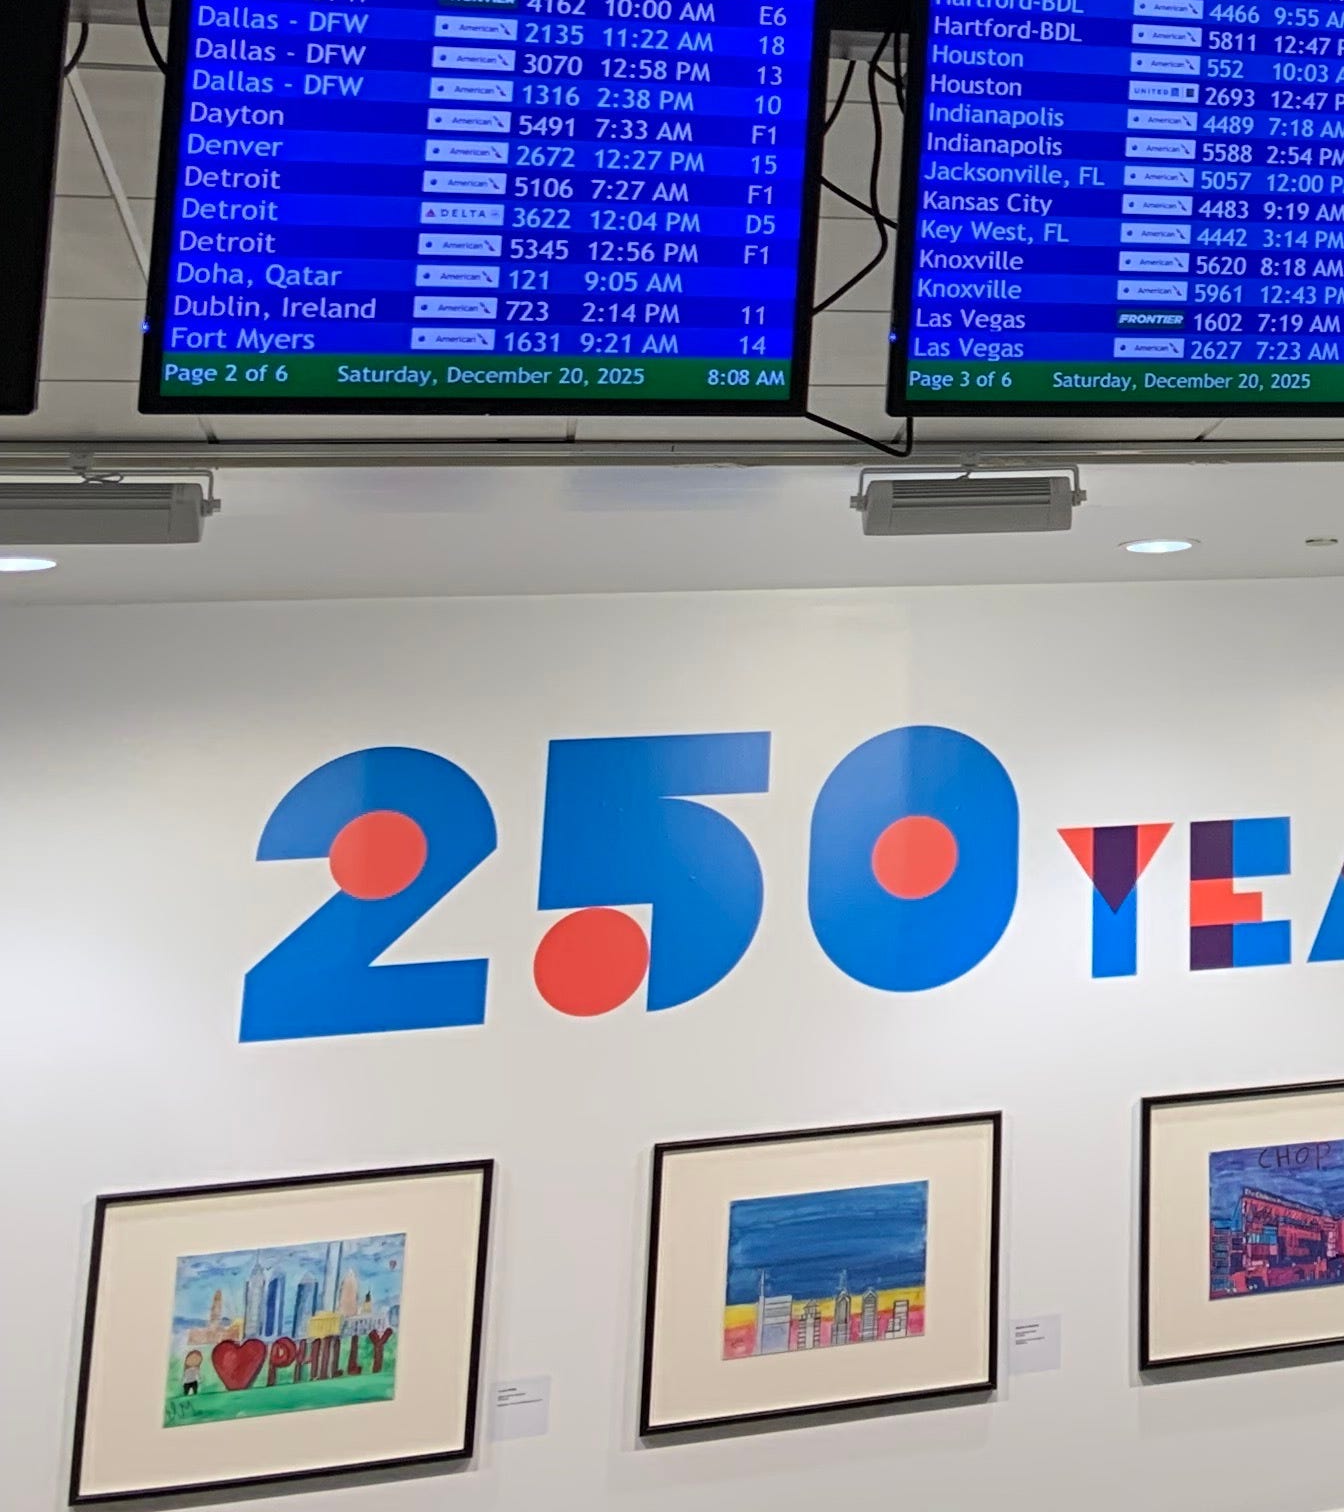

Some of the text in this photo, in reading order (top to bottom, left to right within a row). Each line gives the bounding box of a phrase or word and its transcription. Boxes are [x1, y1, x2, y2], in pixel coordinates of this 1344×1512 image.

[1209, 4, 1260, 23] 4466
[1274, 7, 1319, 27] 9:55
[182, 198, 775, 235] Detroit DELTA 3622 12:04 PM D5
[916, 308, 952, 327] Las
[960, 309, 1025, 331] Vegas
[1118, 313, 1185, 325] FRONTIER
[1194, 313, 1242, 331] 1602
[1258, 314, 1303, 332] 7:19
[1309, 315, 1340, 332] AM
[165, 364, 785, 386] Page 2 of 6 Saturday, December 20, 2025 8:08 AM
[238, 724, 1020, 1044] 250
[1257, 1142, 1332, 1170] CHOP
[267, 1326, 393, 1387] PHILLY
